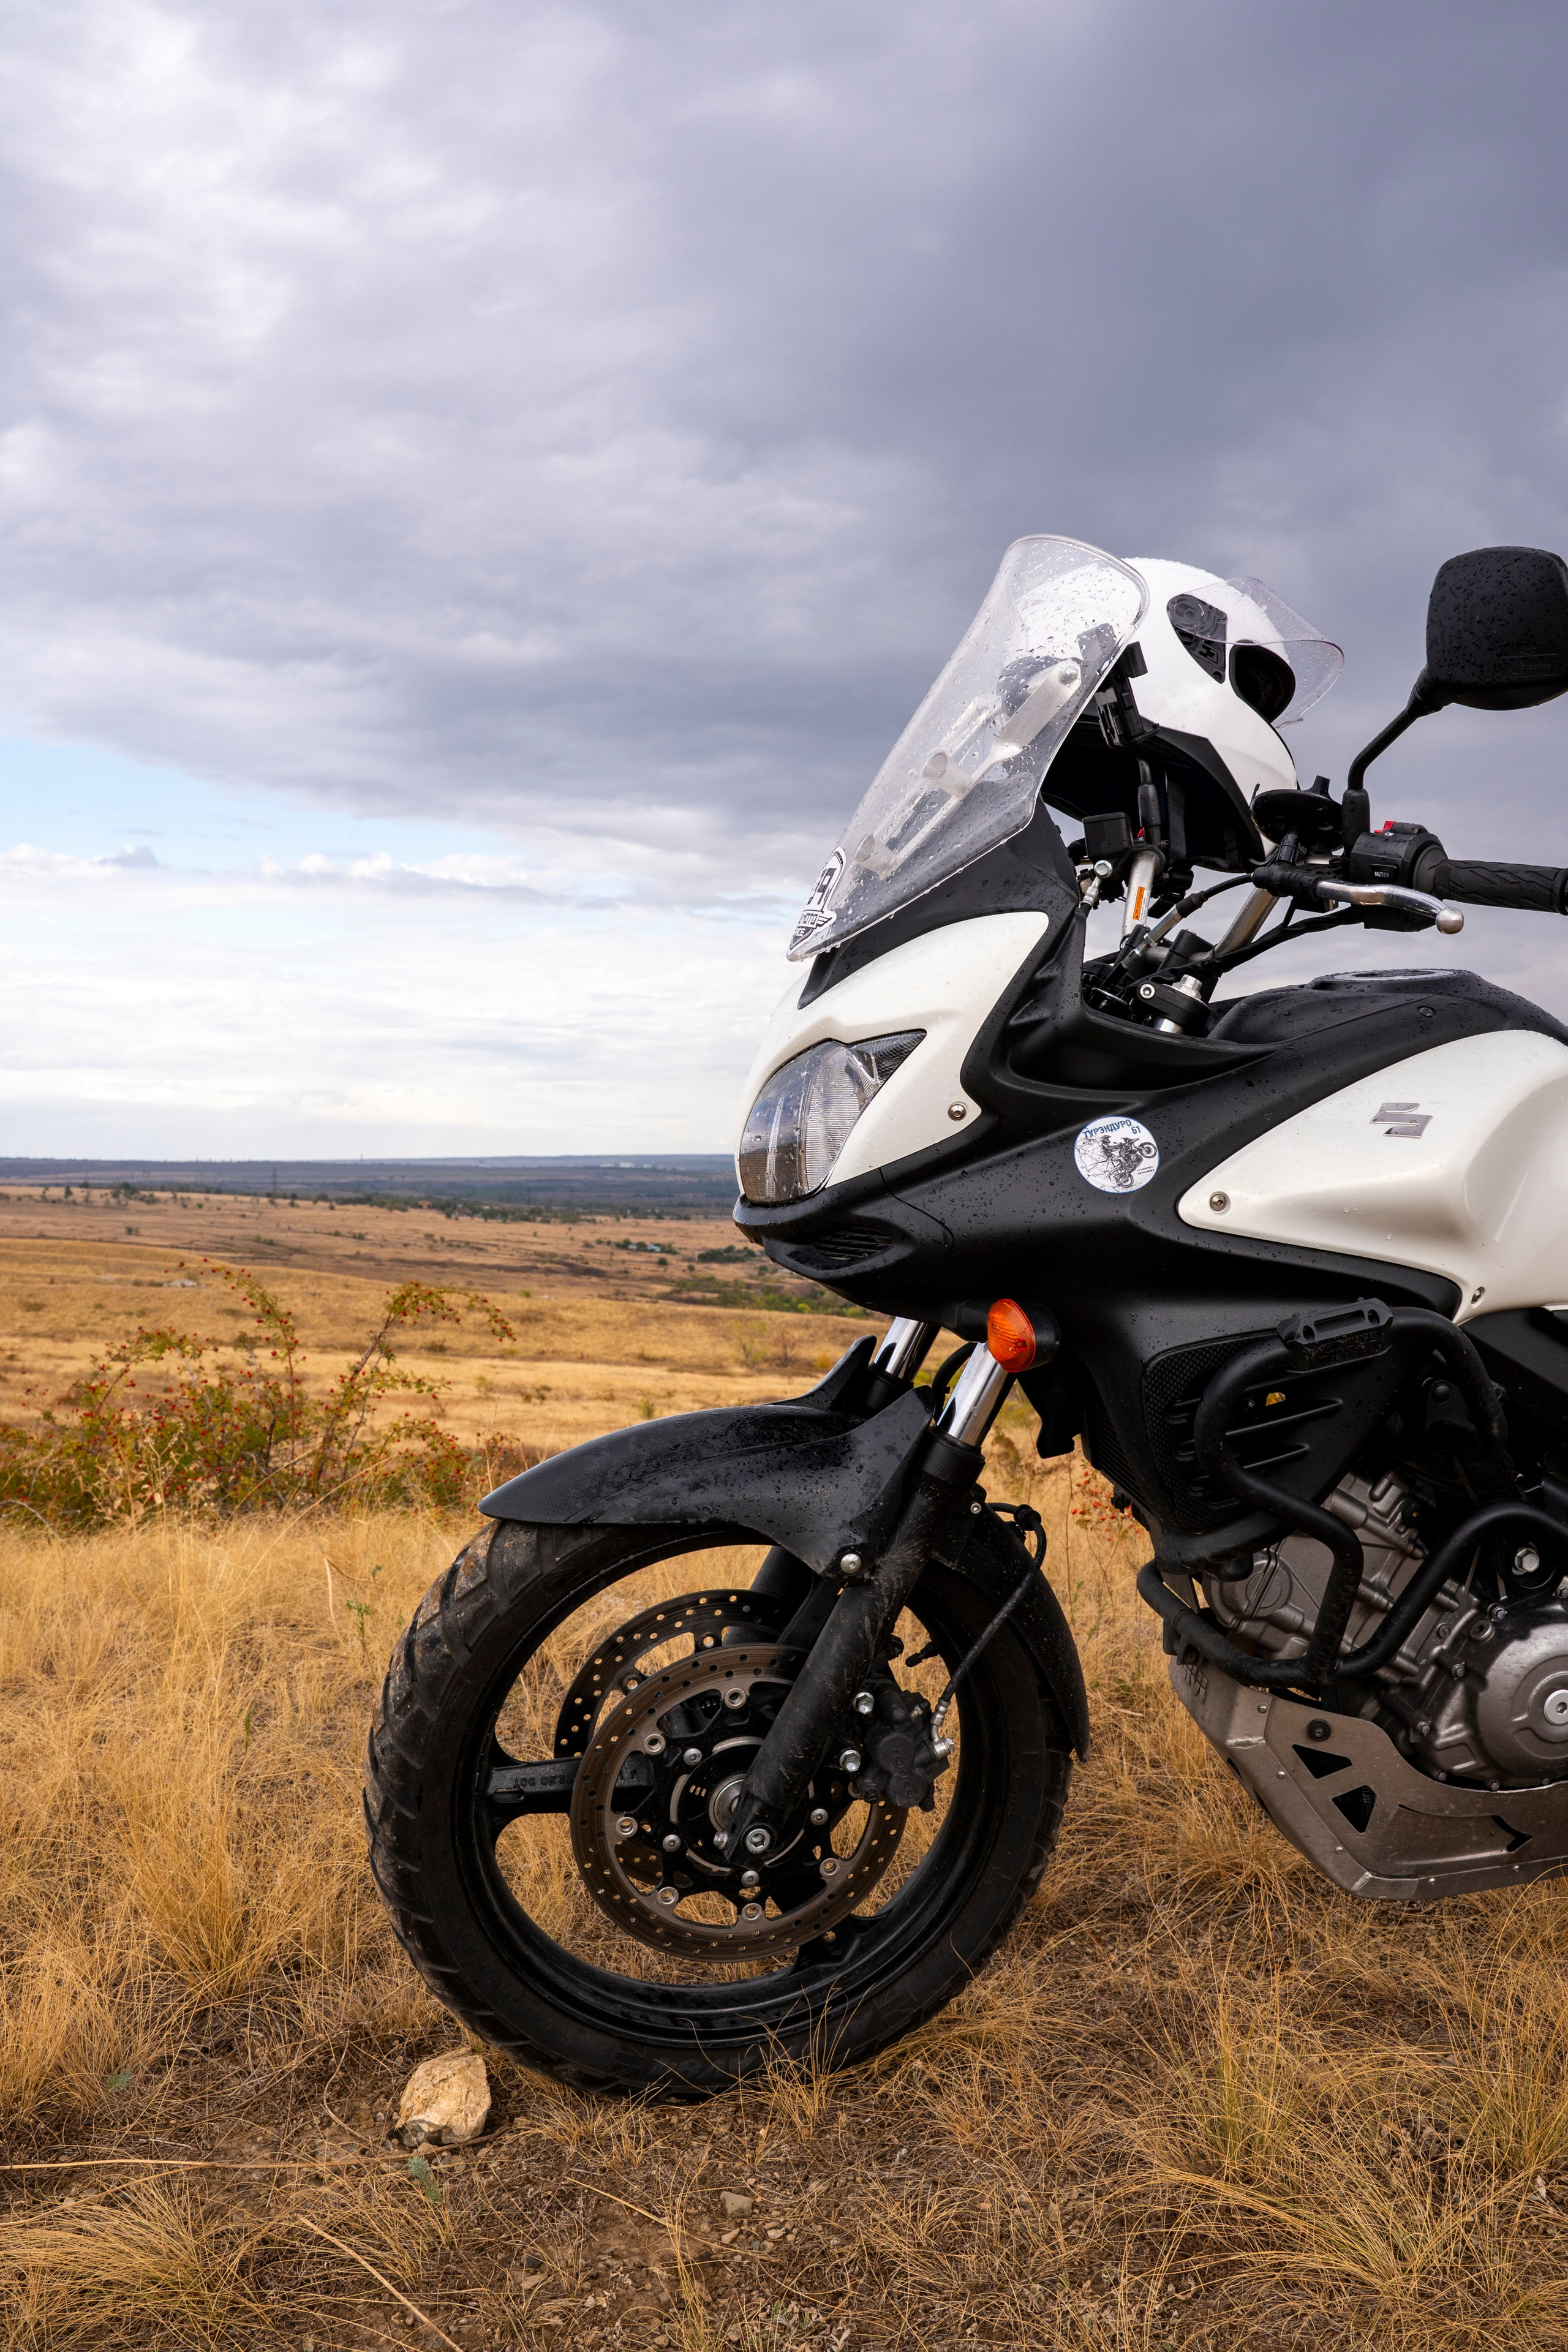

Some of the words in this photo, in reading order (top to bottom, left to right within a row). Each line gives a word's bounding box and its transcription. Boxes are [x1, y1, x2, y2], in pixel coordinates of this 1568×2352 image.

[1082, 1119, 1132, 1139] ТУРЭНДУРО
[1132, 1126, 1142, 1134] 61
[513, 1776, 535, 1787] DOT
